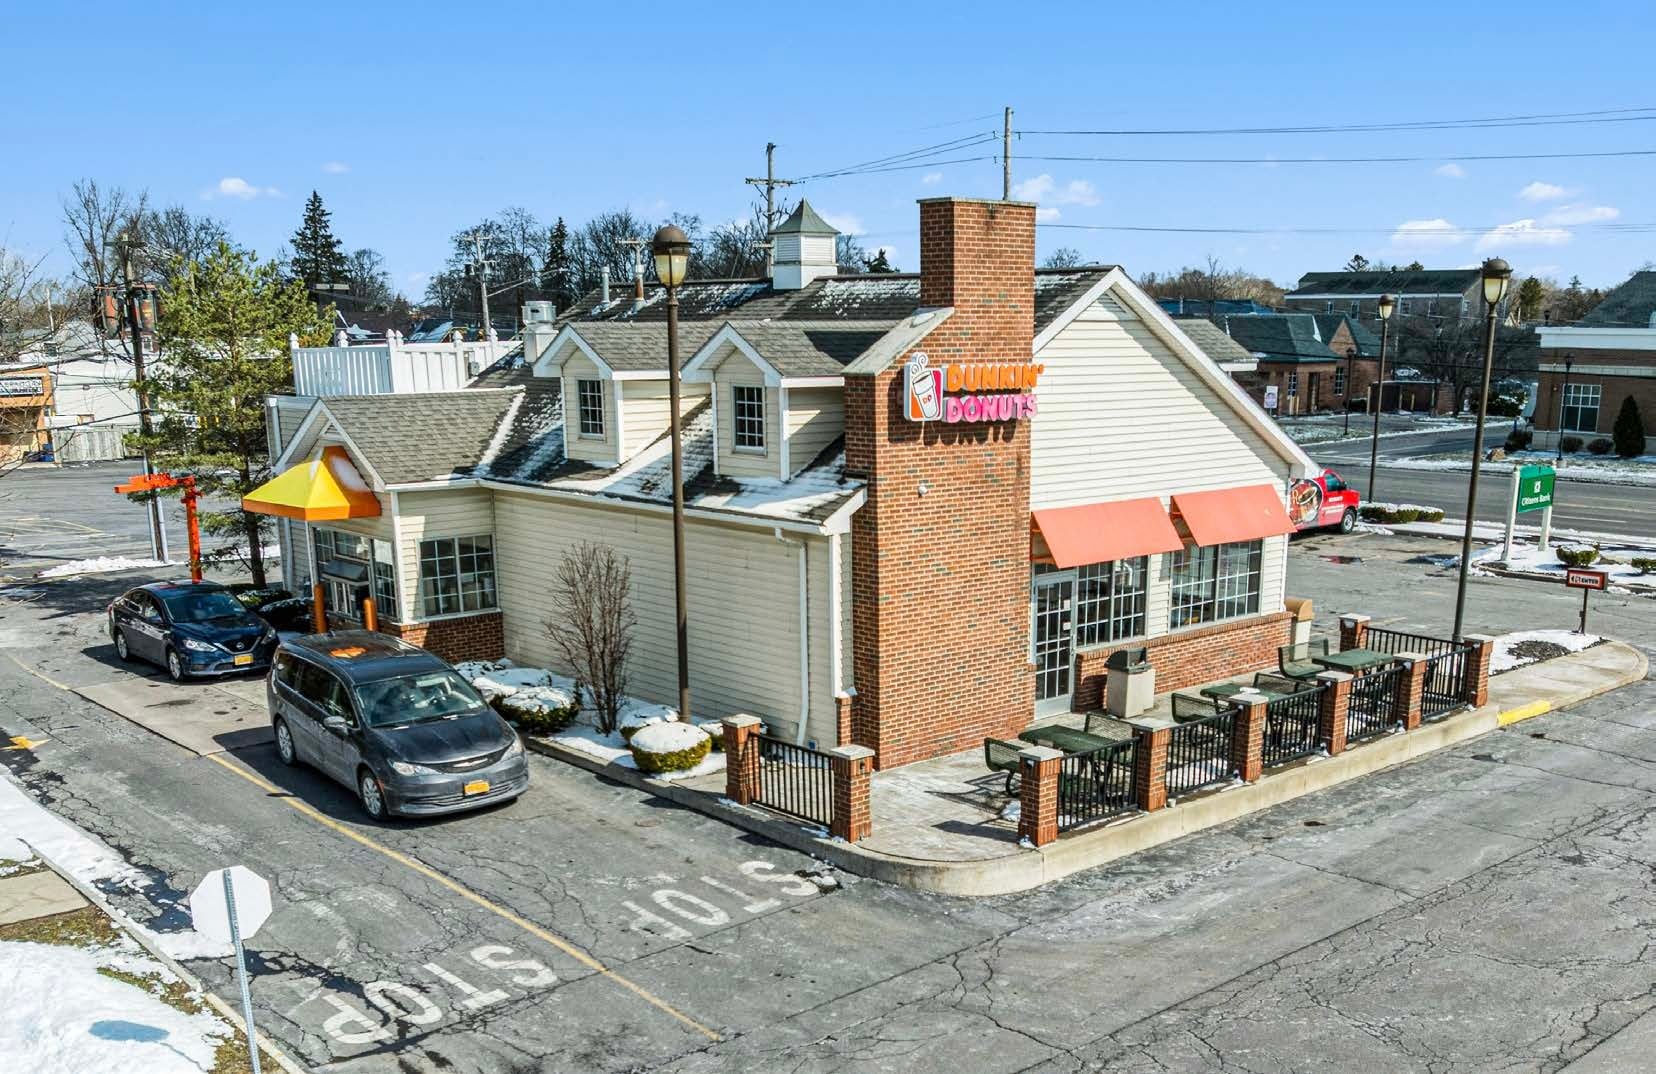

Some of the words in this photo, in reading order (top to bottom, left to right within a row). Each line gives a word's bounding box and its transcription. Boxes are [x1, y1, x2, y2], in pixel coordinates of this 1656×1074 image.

[946, 363, 1045, 392] DUNKIN'
[946, 394, 1037, 423] DONUTS
[622, 860, 820, 940] STOP
[322, 945, 558, 1043] STOP
